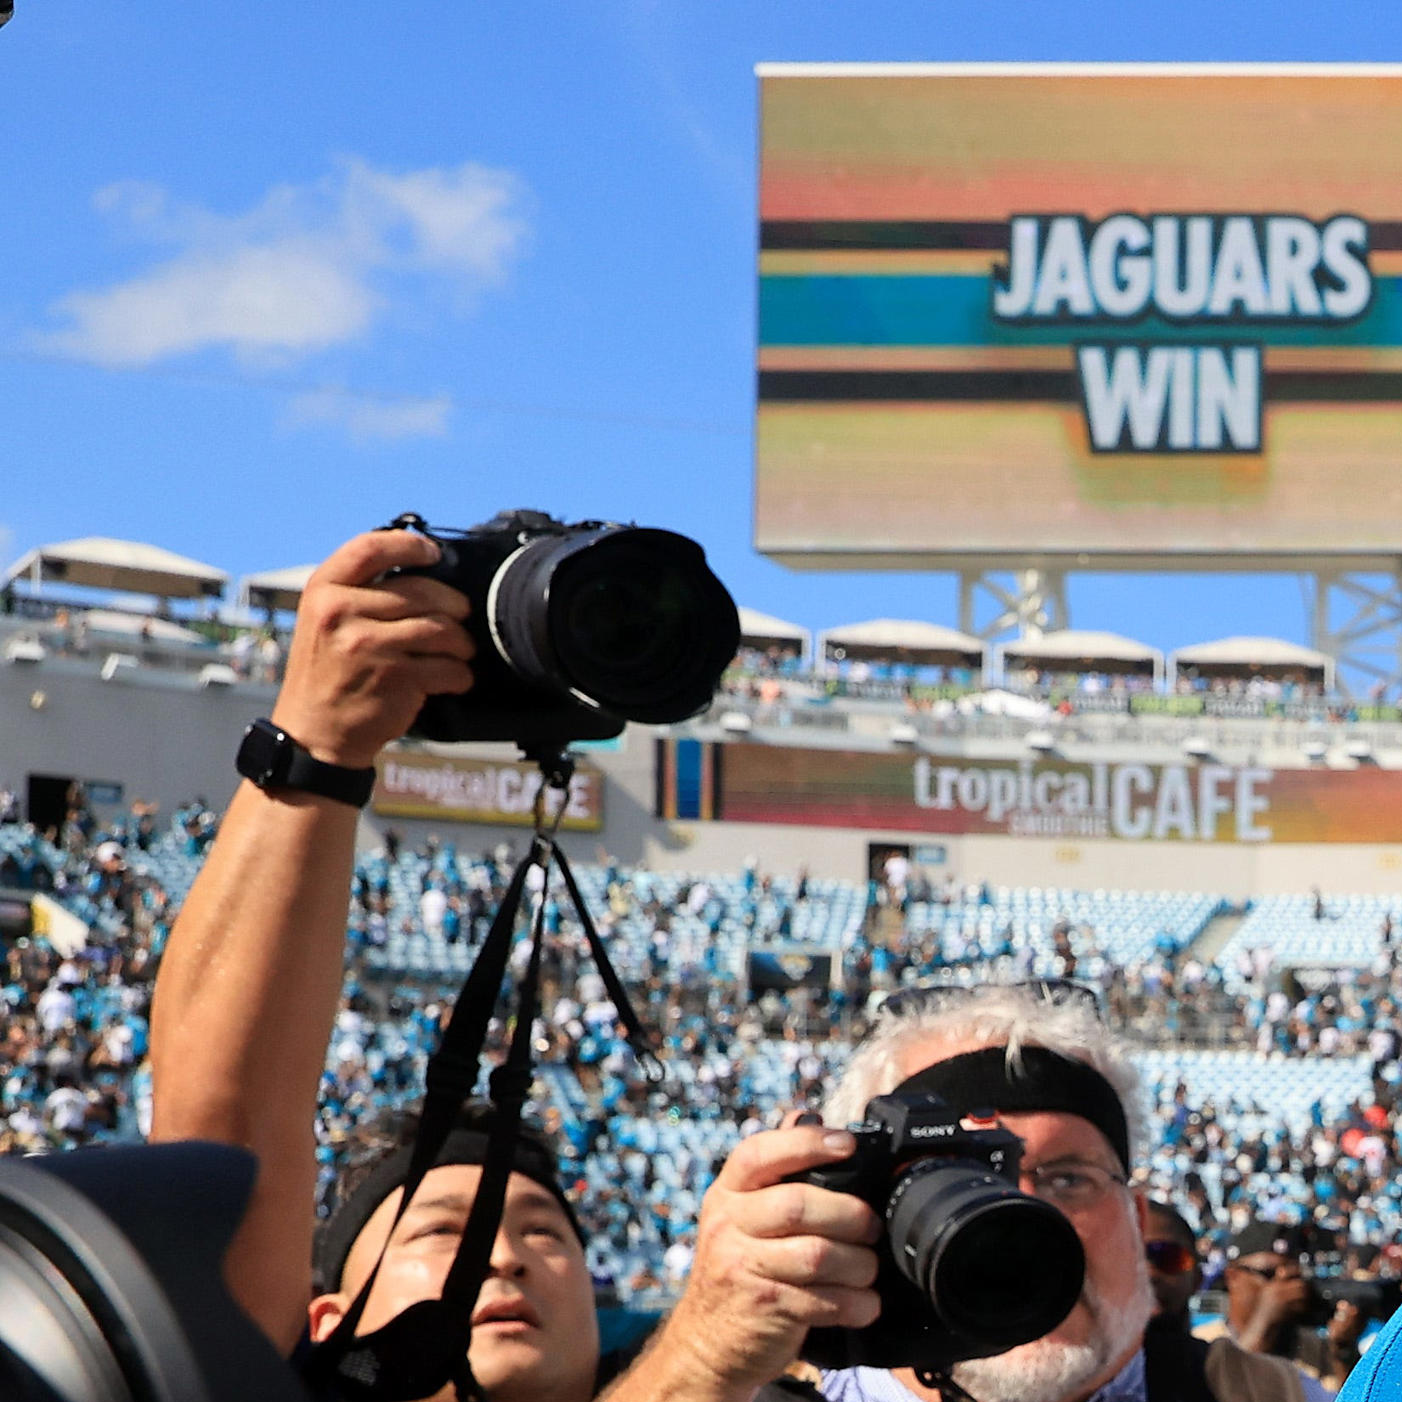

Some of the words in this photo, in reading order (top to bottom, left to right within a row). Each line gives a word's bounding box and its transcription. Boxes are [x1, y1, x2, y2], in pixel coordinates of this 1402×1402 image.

[994, 214, 1372, 319] JAGUARS
[1079, 346, 1261, 450] WIN
[912, 756, 1109, 822] tropical
[1111, 763, 1274, 842] CAFE
